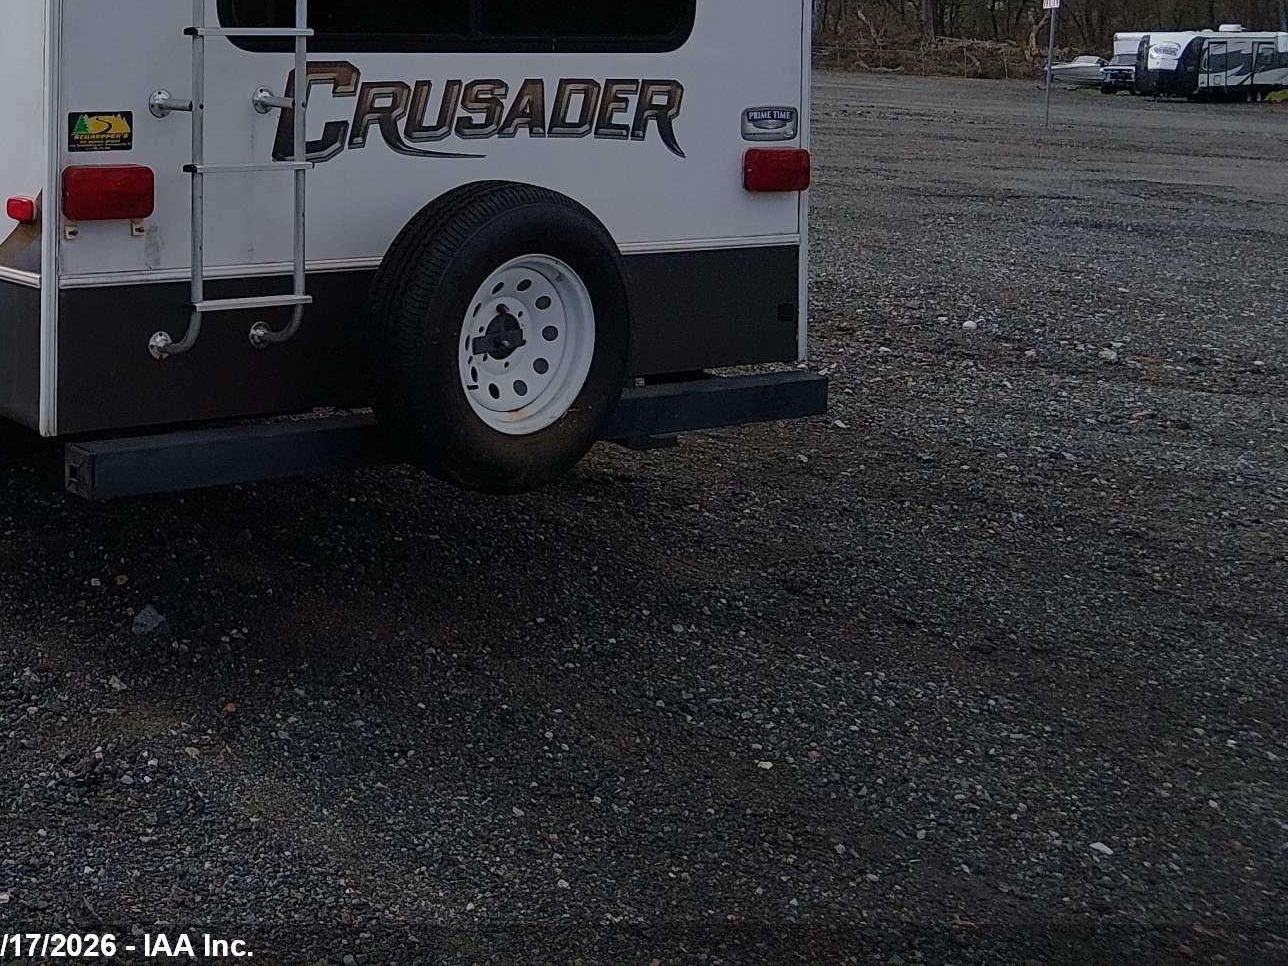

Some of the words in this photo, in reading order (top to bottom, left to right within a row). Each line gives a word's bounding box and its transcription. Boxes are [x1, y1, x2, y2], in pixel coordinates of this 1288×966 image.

[272, 60, 686, 163] CRUSADER
[748, 110, 772, 120] PRIME
[773, 110, 792, 120] TIME
